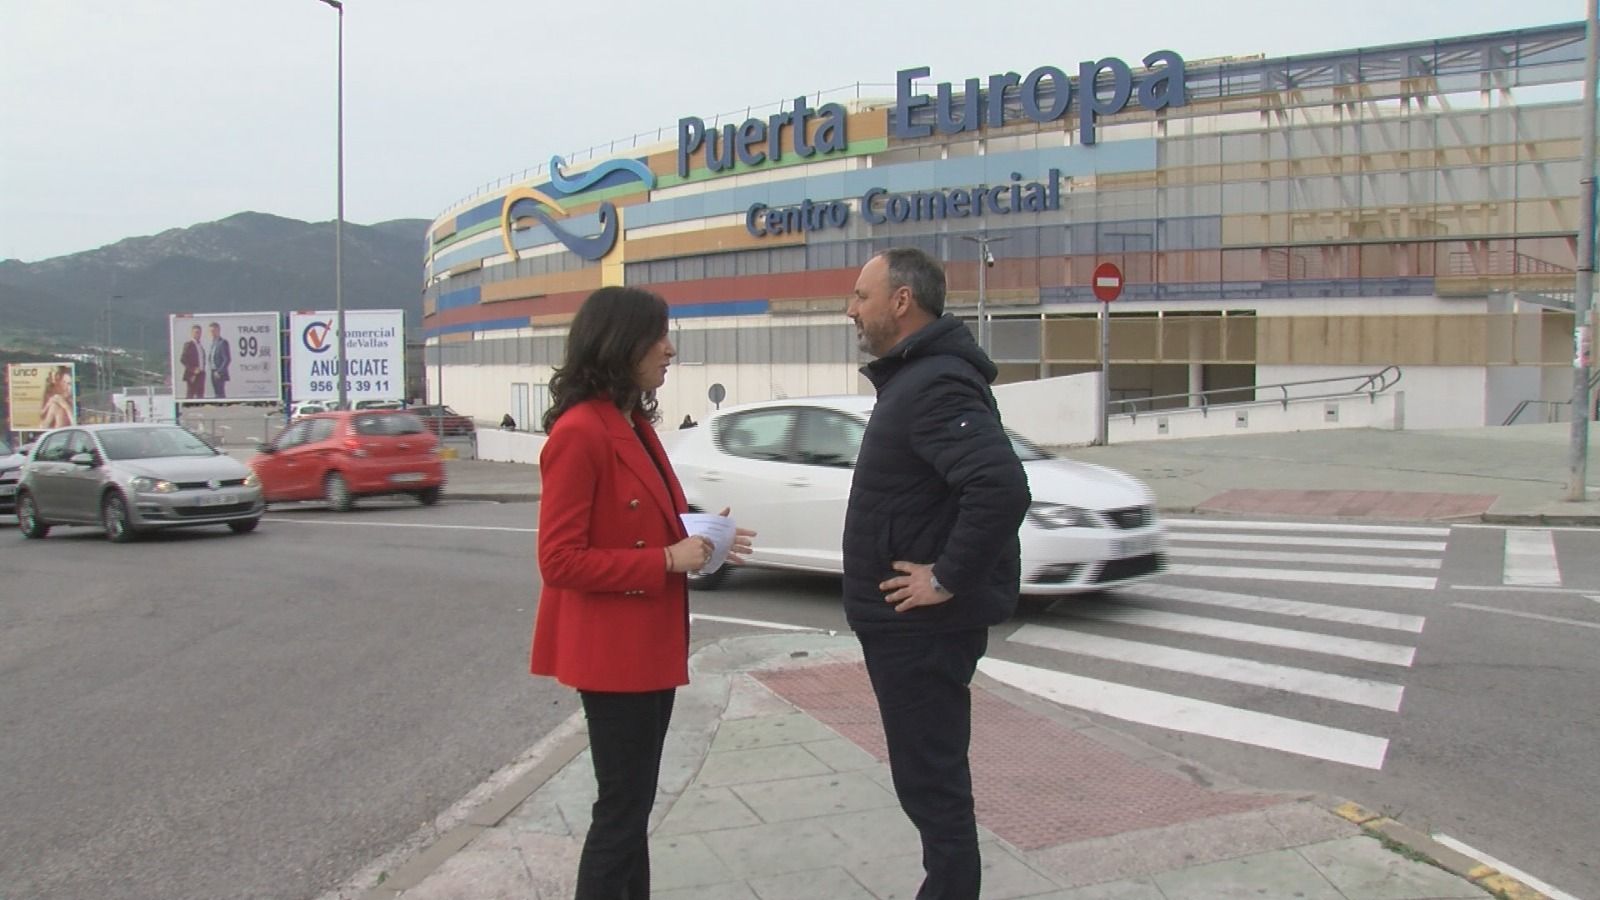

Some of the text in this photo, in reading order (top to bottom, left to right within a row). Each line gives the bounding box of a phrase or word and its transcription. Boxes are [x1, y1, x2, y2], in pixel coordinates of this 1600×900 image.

[678, 49, 1186, 178] Puerta Europa
[746, 168, 1061, 237] Centro Comercial
[336, 327, 395, 338] omercial
[239, 336, 258, 357] 99
[310, 381, 333, 392] 956
[355, 381, 371, 392] 39
[375, 381, 389, 392] 11
